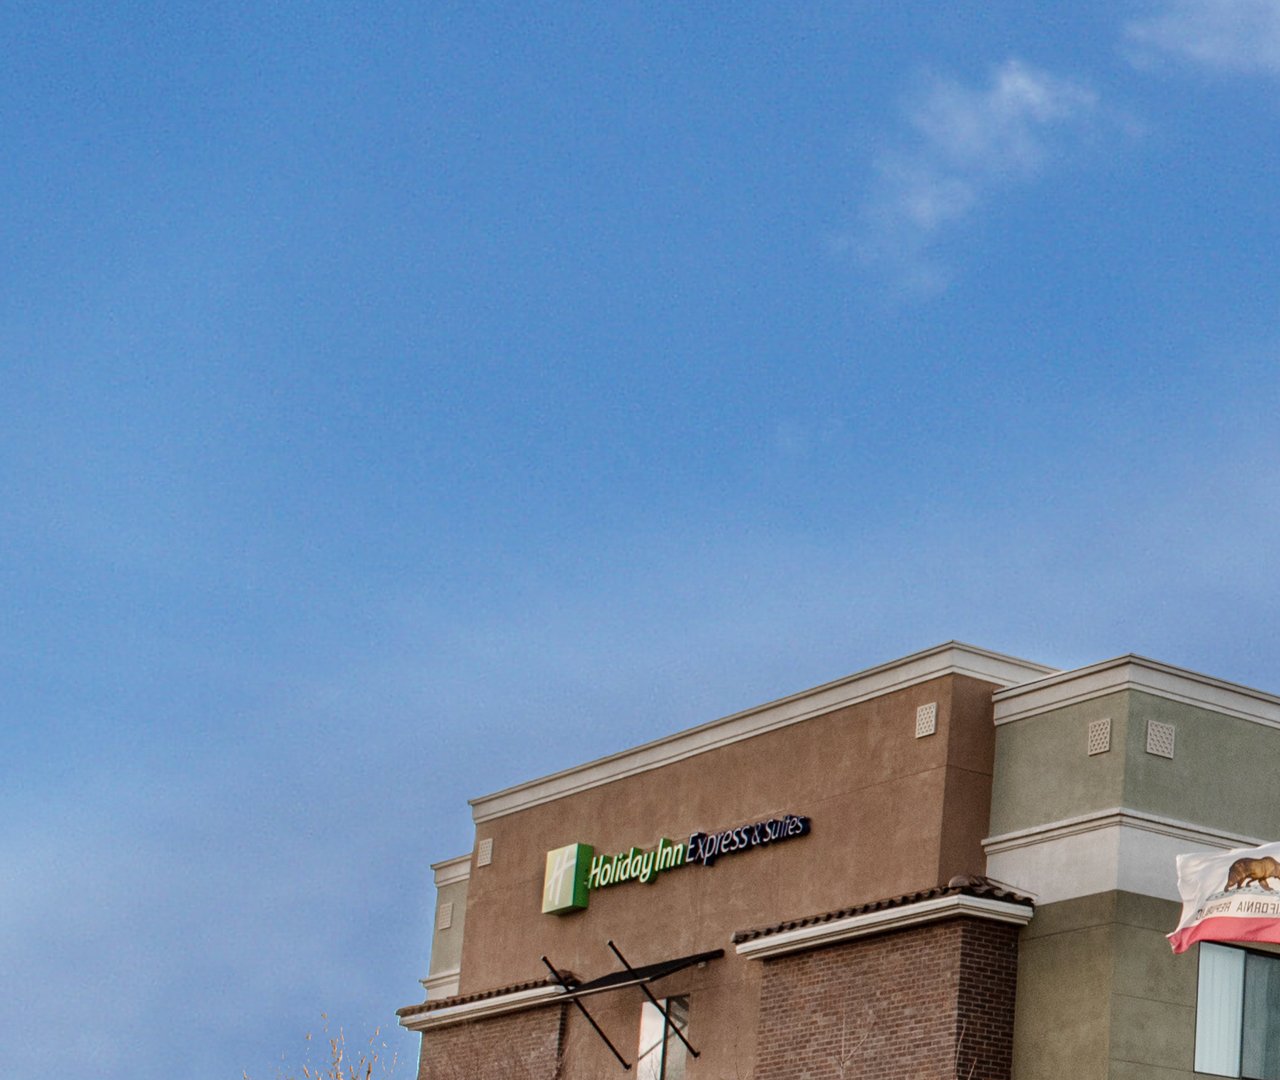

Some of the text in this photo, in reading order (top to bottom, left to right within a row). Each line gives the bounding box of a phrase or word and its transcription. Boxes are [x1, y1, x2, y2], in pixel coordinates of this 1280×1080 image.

[588, 815, 804, 888] Holiday Inn Express & Suites
